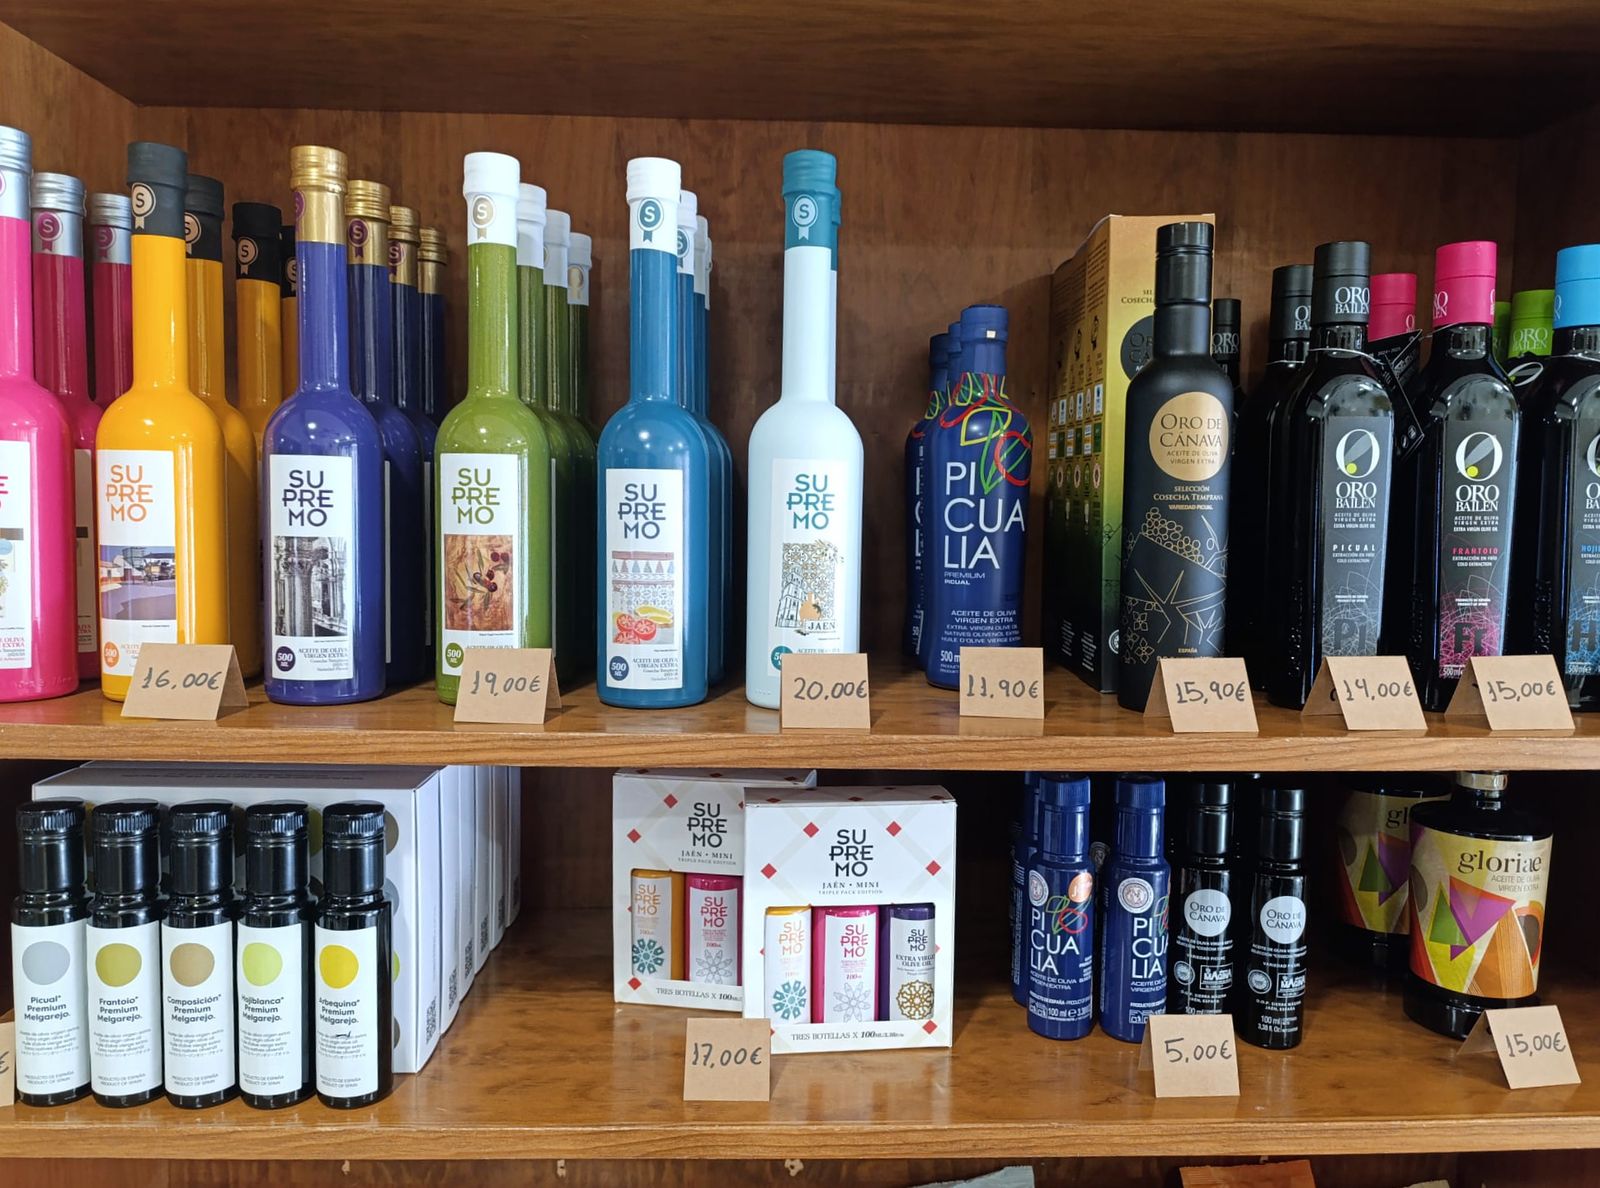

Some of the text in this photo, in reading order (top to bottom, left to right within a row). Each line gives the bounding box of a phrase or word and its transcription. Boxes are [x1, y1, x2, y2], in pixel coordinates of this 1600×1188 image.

[136, 192, 145, 208] S
[477, 204, 487, 219] S
[644, 207, 654, 222] S
[800, 204, 809, 218] S
[42, 218, 53, 233] S
[1121, 296, 1155, 304] COSECH
[1335, 287, 1370, 304] ORO
[1336, 303, 1370, 314] BAILEN
[1512, 327, 1548, 344] ORO
[110, 464, 143, 484] SU
[290, 470, 324, 488] SU
[458, 468, 491, 487] SU
[946, 462, 976, 496] PI
[795, 474, 828, 492] SU
[1336, 482, 1377, 499] ORO
[106, 484, 154, 503] PRE
[282, 489, 334, 508] PRE
[452, 488, 500, 505] PRE
[624, 484, 657, 502] SU
[1456, 484, 1500, 502] ORO
[786, 493, 835, 512] PRE
[1336, 498, 1376, 508] BAILEN
[1456, 501, 1498, 512] BAILEN
[110, 504, 147, 522] MO
[288, 508, 328, 527] MO
[457, 506, 494, 524] MO
[618, 503, 666, 520] PRE
[944, 498, 1025, 533] CUA
[793, 512, 829, 530] MO
[624, 522, 660, 539] MO
[944, 535, 1000, 569] LIA
[277, 653, 293, 662] 500
[446, 649, 462, 658] 500
[940, 650, 953, 662] 500
[611, 662, 626, 671] 500
[142, 666, 222, 691] 16,00€
[1176, 680, 1245, 704] 15,90€
[1344, 678, 1413, 701] 14,00€
[1488, 680, 1556, 702] 15,00€
[694, 802, 720, 817] SU
[687, 818, 727, 833] PRE
[692, 834, 722, 848] MO
[837, 830, 866, 844] SU
[829, 845, 874, 861] PRE
[835, 862, 868, 877] MO
[1458, 850, 1542, 874] gloriae
[1491, 874, 1515, 884] ACEITE
[1517, 875, 1525, 884] DE
[1499, 884, 1522, 893] VIRGEN
[704, 897, 724, 907] SU
[700, 907, 728, 917] PRE
[1032, 907, 1045, 928] PI
[704, 918, 724, 928] MO
[845, 924, 865, 936] SU
[1134, 918, 1152, 937] PI
[840, 934, 869, 947] PRE
[908, 936, 928, 944] PRE
[1031, 930, 1080, 956] CUA
[844, 947, 865, 958] MO
[1030, 948, 1059, 976] LIA
[1132, 957, 1163, 979] LIA
[27, 1003, 67, 1012] Premium
[100, 1005, 138, 1014] Premium
[174, 1006, 211, 1014] Premium
[245, 1004, 278, 1013] Premium
[322, 1006, 355, 1015] Premium
[1048, 1008, 1058, 1016] 100
[1164, 1038, 1233, 1063] 5,00€
[1505, 1032, 1566, 1056] 15,00€
[692, 1042, 762, 1069] 17,00€
